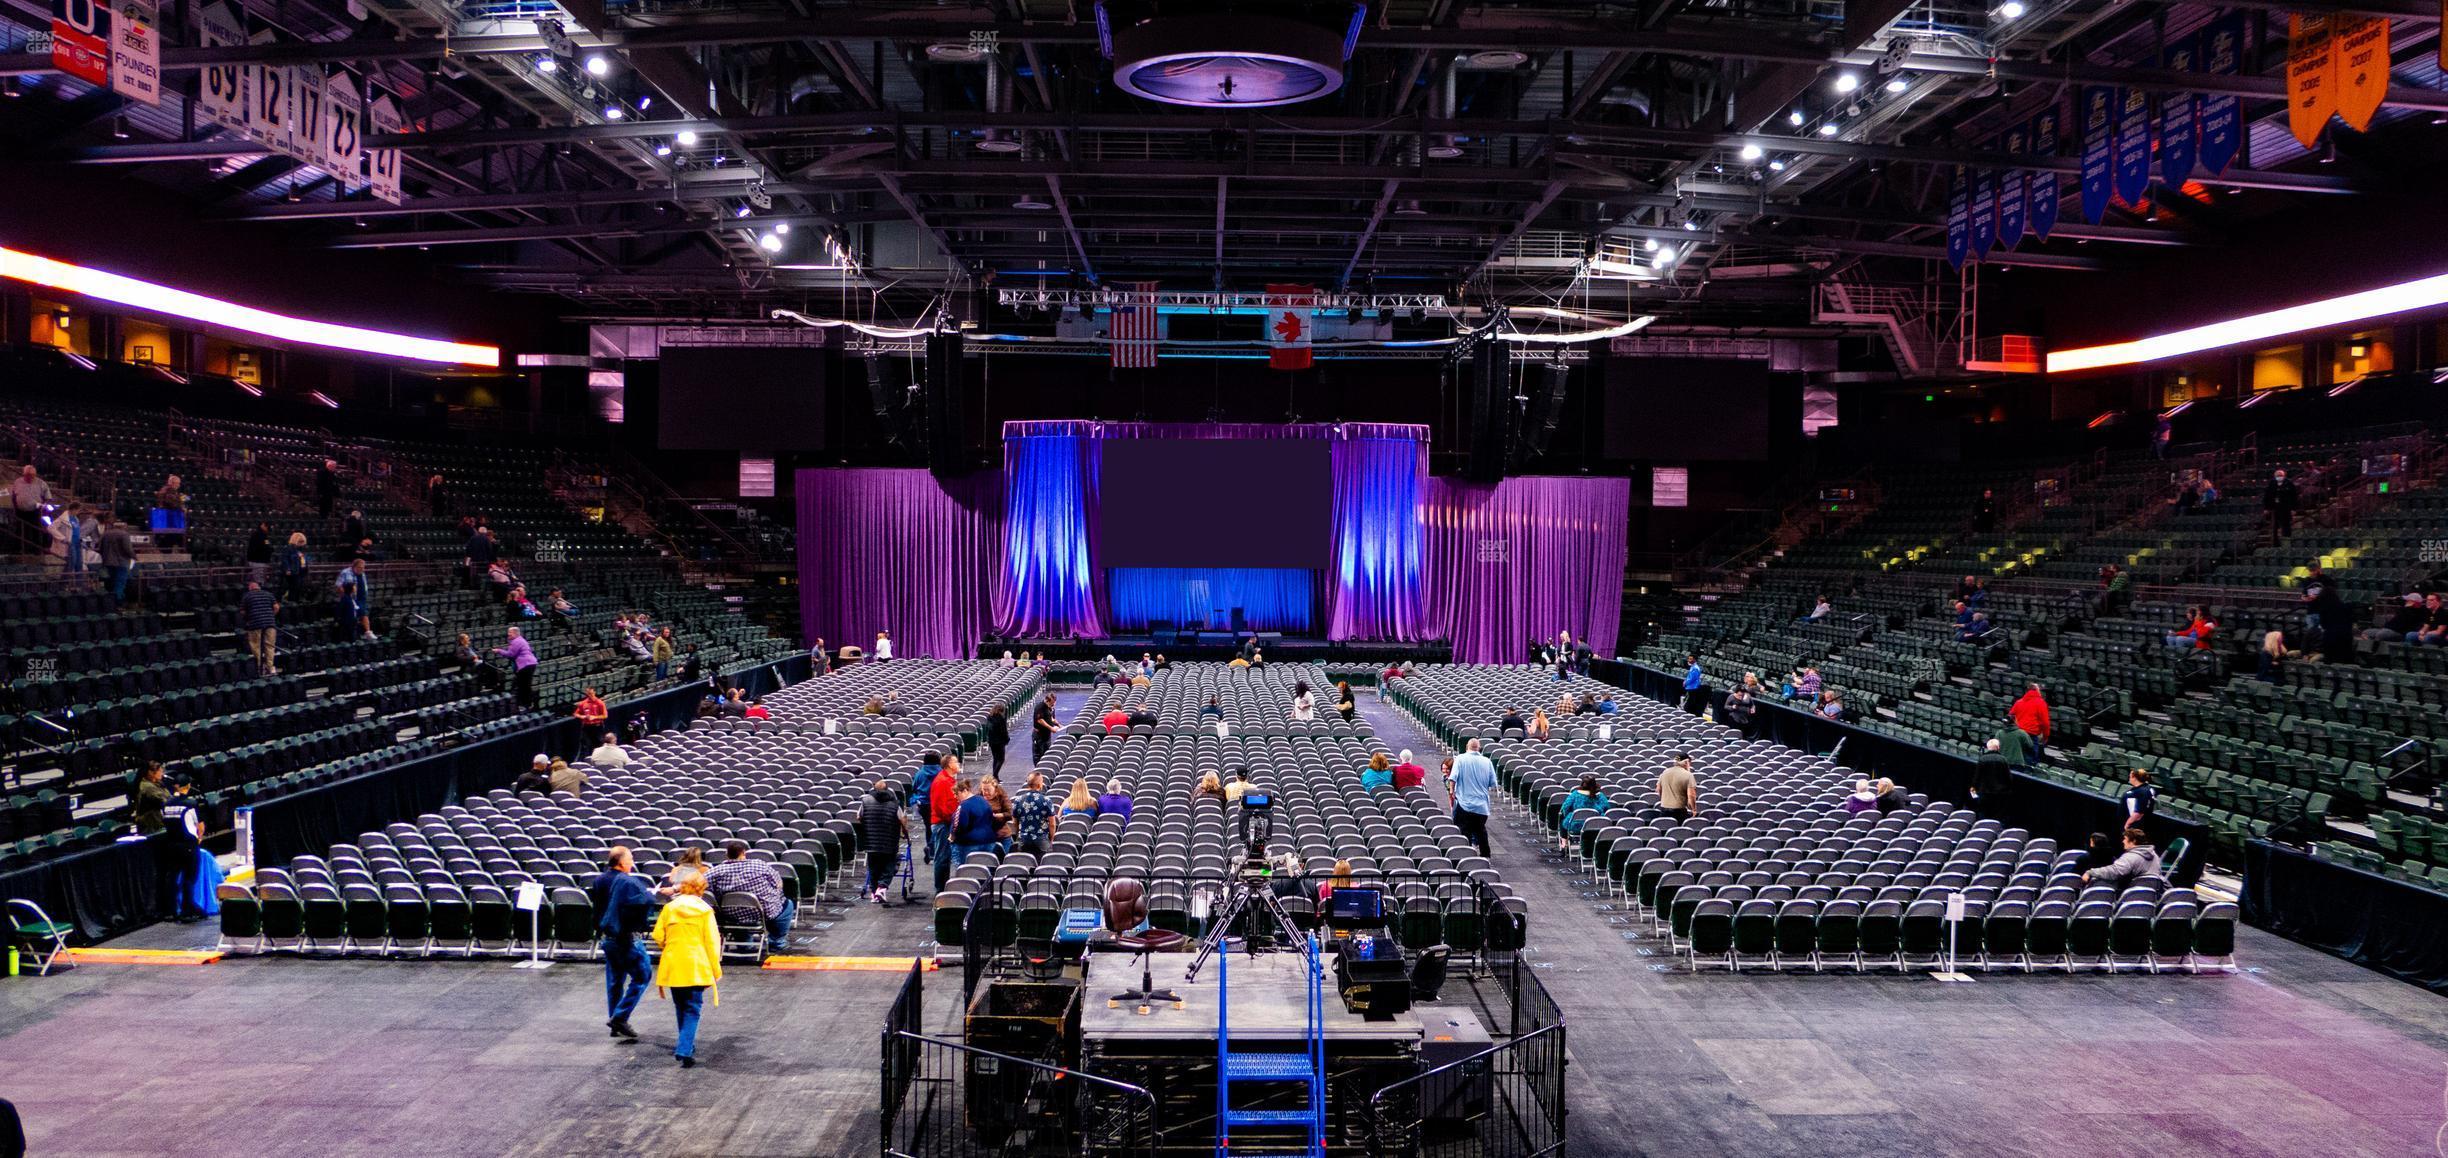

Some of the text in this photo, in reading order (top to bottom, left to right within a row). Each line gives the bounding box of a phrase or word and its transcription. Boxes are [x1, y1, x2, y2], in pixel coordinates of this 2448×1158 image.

[115, 53, 157, 80] FOUNDER
[261, 66, 281, 126] 12
[302, 86, 320, 142] 17
[335, 104, 355, 157] 23
